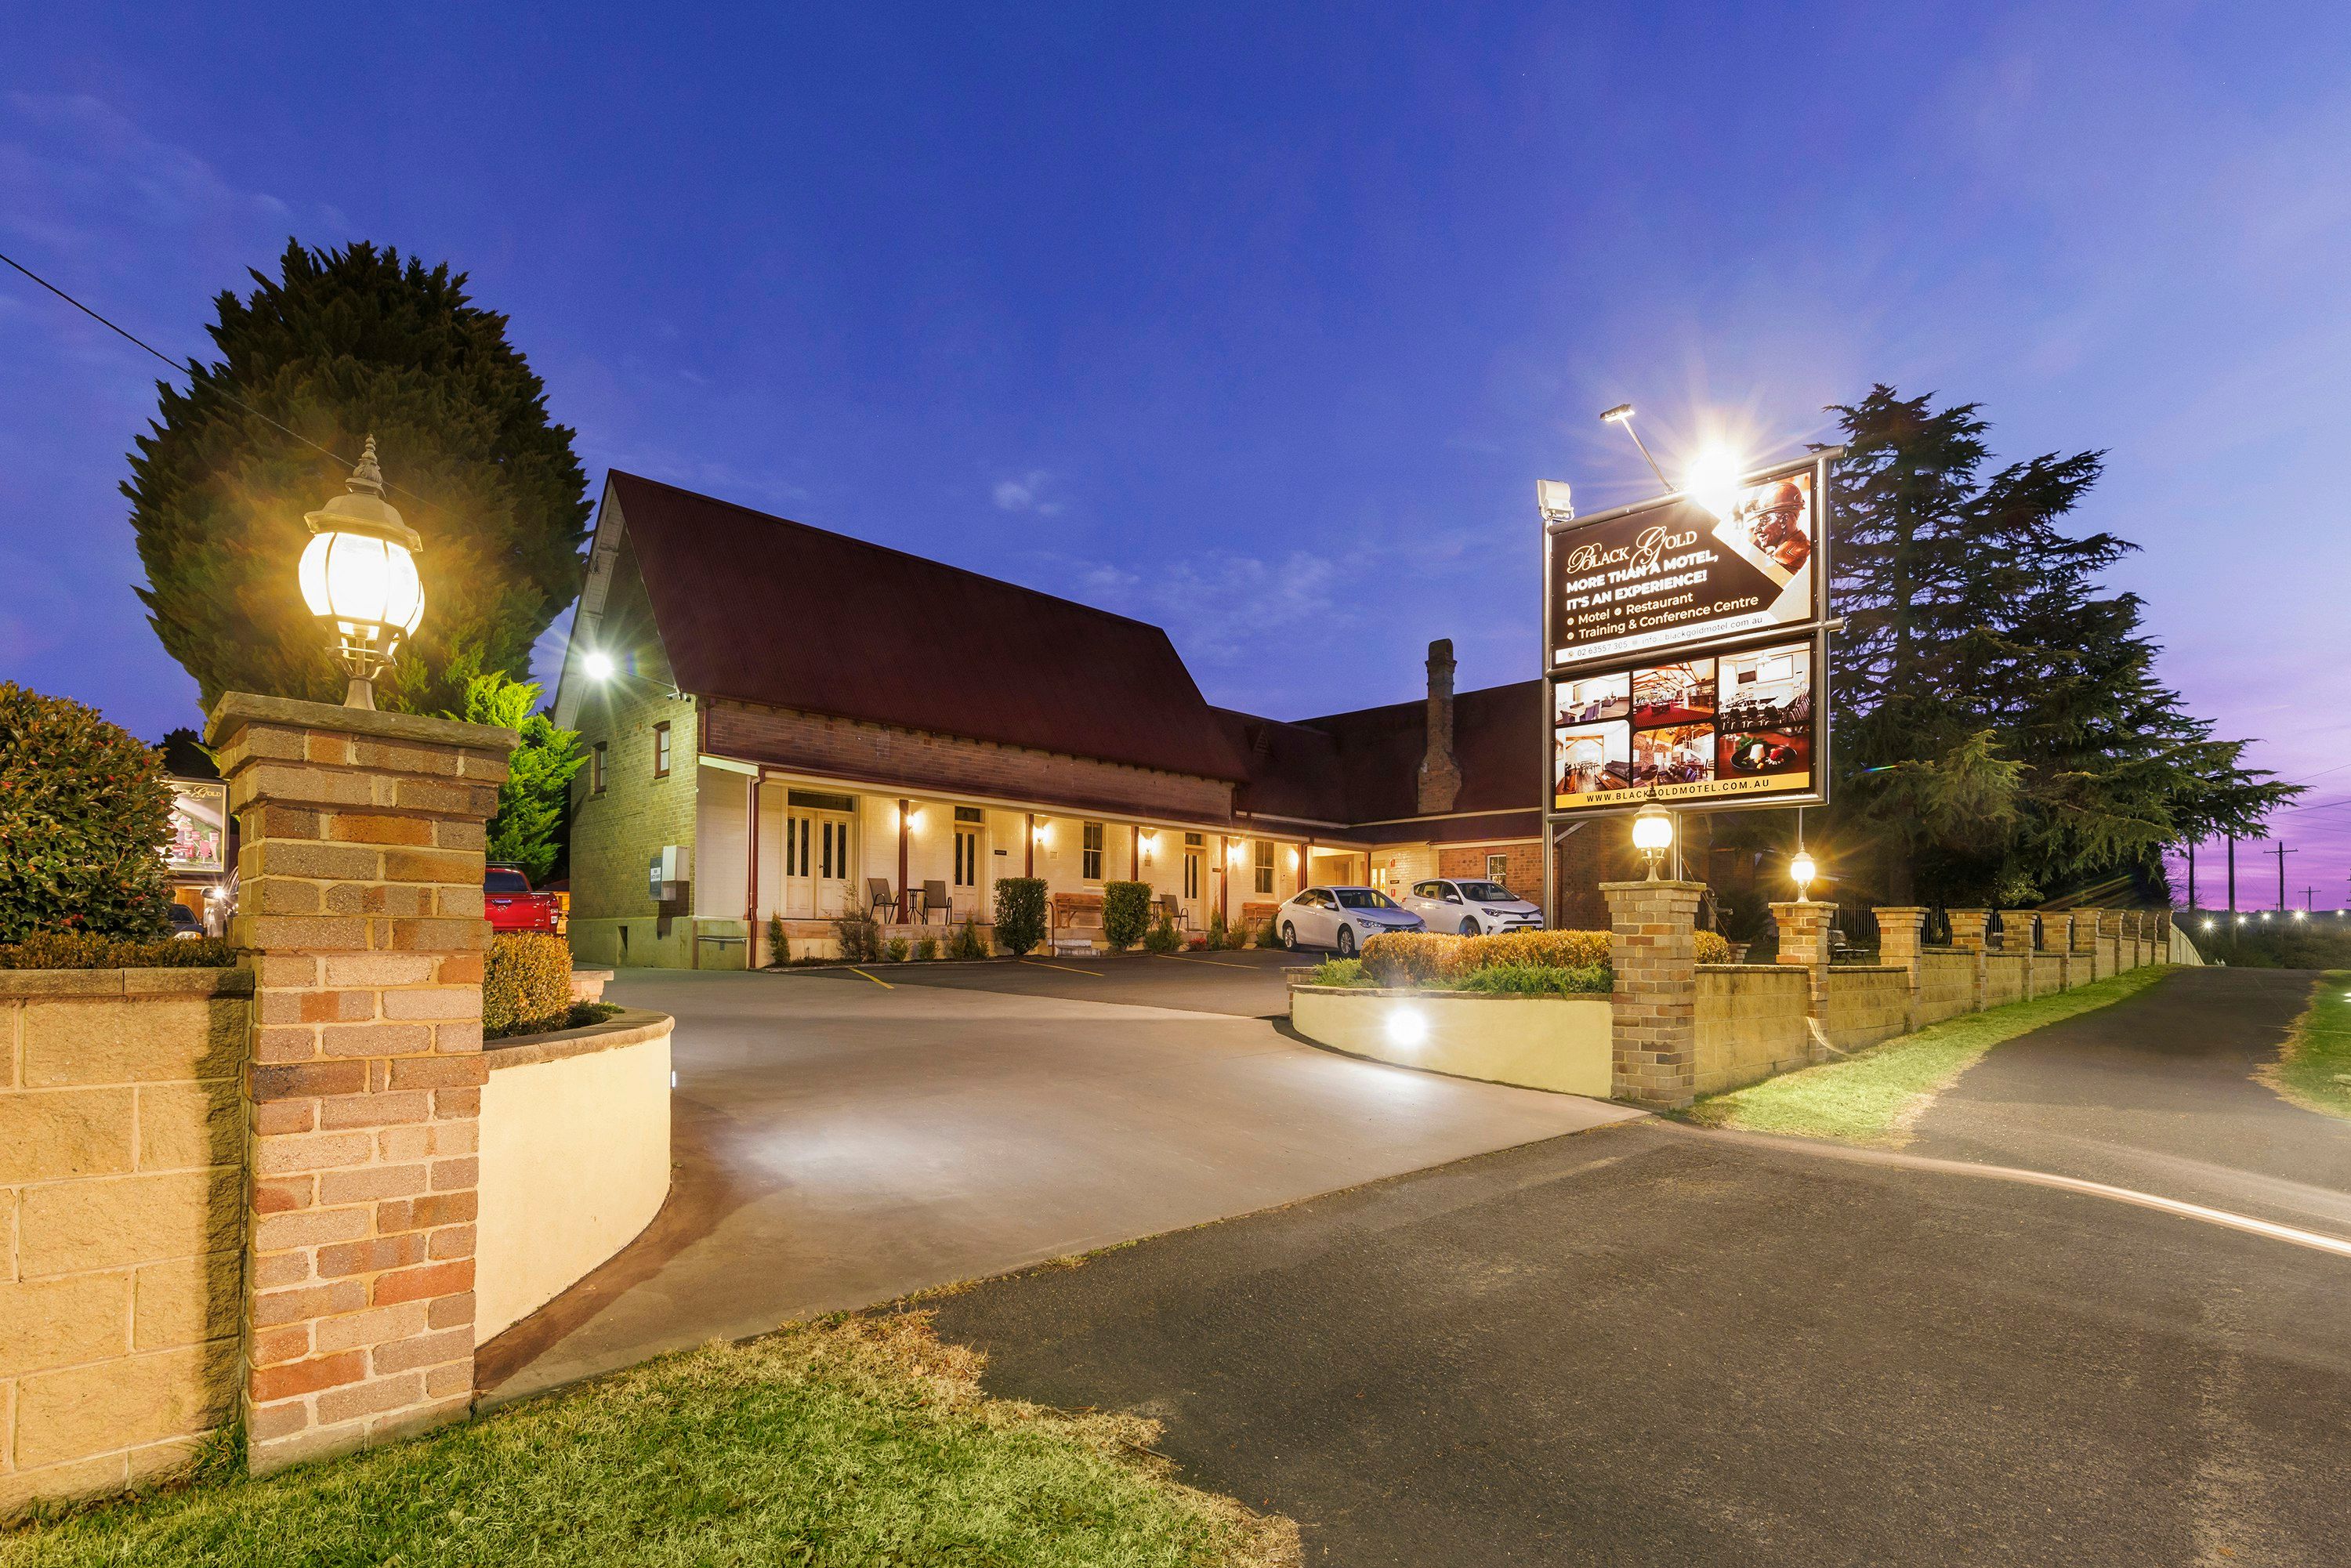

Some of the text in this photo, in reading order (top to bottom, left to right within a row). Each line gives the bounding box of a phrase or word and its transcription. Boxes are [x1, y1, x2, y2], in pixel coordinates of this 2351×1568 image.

[1567, 542, 1630, 574] BLACK
[1567, 549, 1719, 593] MORE THAN A MOTEL,
[1567, 570, 1708, 610] IT'S AN EXPERIENCE!
[1578, 592, 1694, 625] Motel Restaurant
[1578, 596, 1759, 639] Training & Conference Centre
[1577, 648, 1587, 657] 02
[1586, 779, 1770, 802] WWW.BLACKOLDMOTEL.COM.AU
